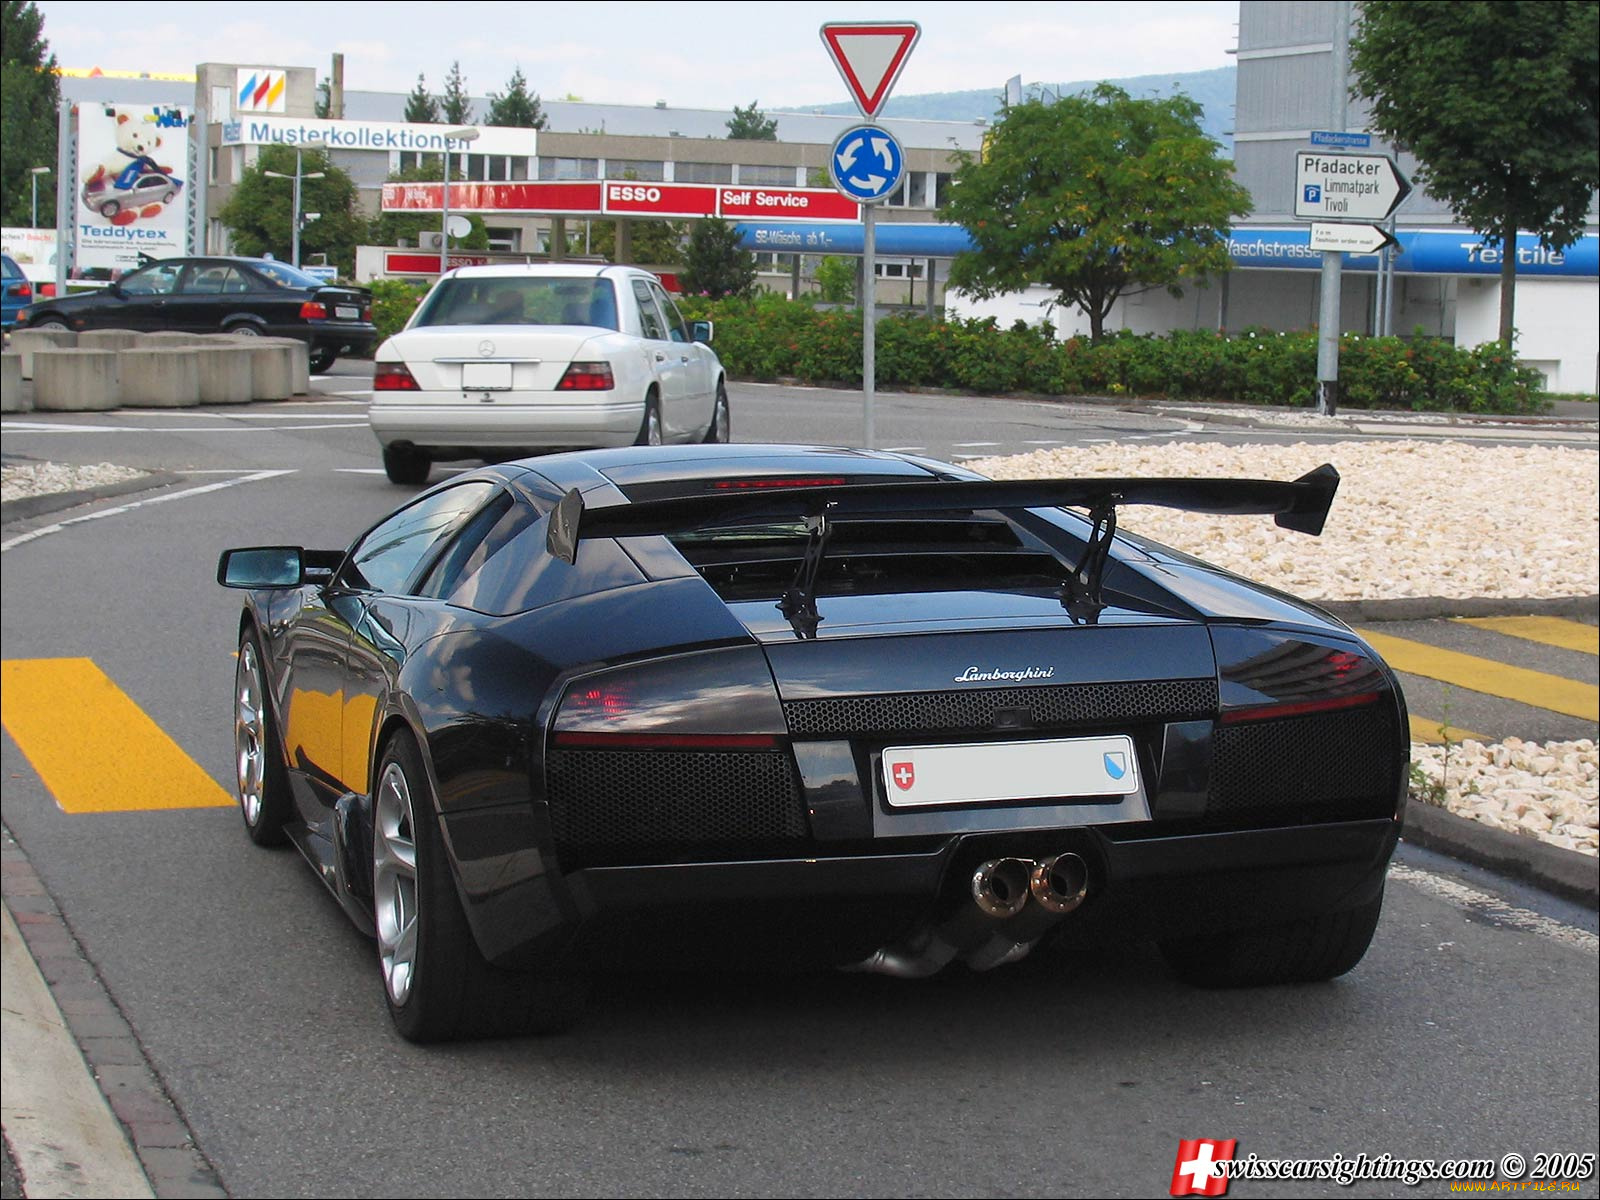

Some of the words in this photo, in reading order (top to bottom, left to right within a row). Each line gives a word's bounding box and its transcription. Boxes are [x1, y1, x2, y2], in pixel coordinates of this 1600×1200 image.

[249, 122, 471, 151] Musterkollektionen
[1304, 157, 1381, 175] Pfadacker
[609, 186, 661, 202] ESSO
[1324, 178, 1380, 198] Limmatpark
[722, 191, 751, 206] Self
[755, 192, 809, 208] Service
[1324, 197, 1348, 213] Tivoli
[80, 225, 167, 240] Teddytex
[1460, 243, 1565, 265] Tetile
[954, 666, 1055, 682] Lamborghini
